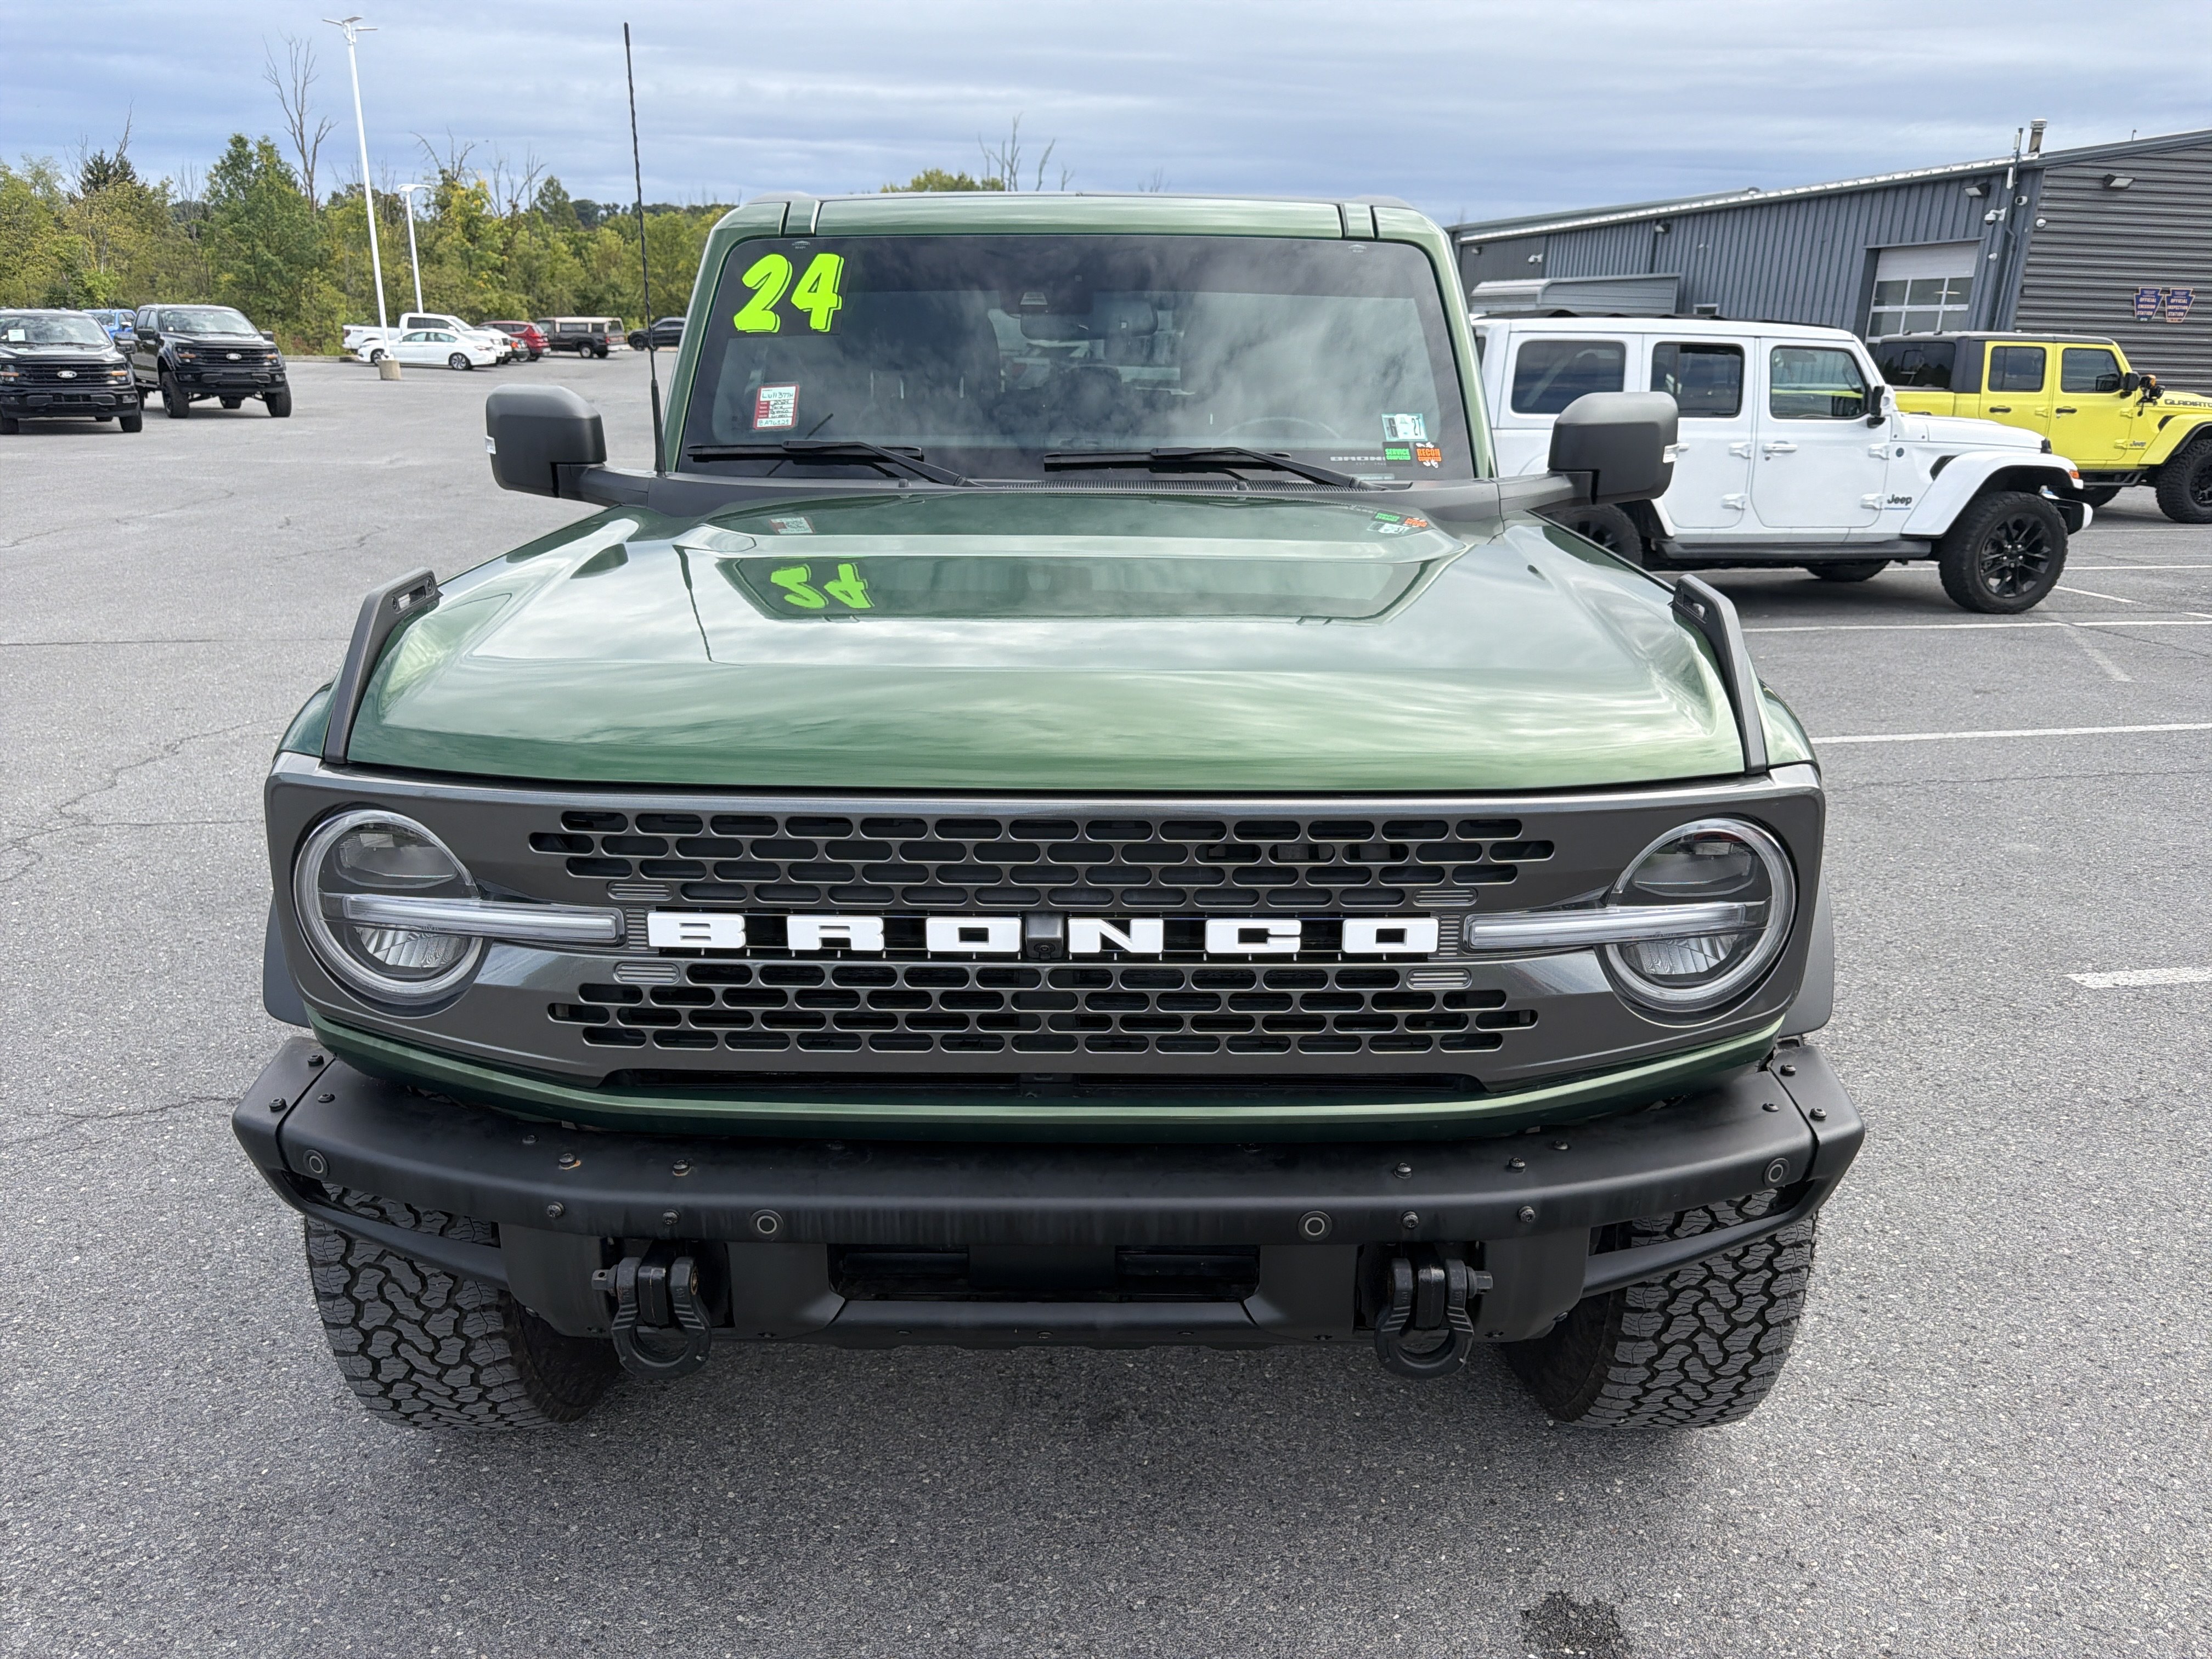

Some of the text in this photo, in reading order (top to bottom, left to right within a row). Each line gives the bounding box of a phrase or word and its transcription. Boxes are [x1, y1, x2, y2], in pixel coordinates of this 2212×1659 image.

[733, 253, 844, 333] 24
[1417, 448, 1441, 456] RECON
[1887, 494, 1912, 506] Jeep
[647, 911, 1439, 954] BRONCO
